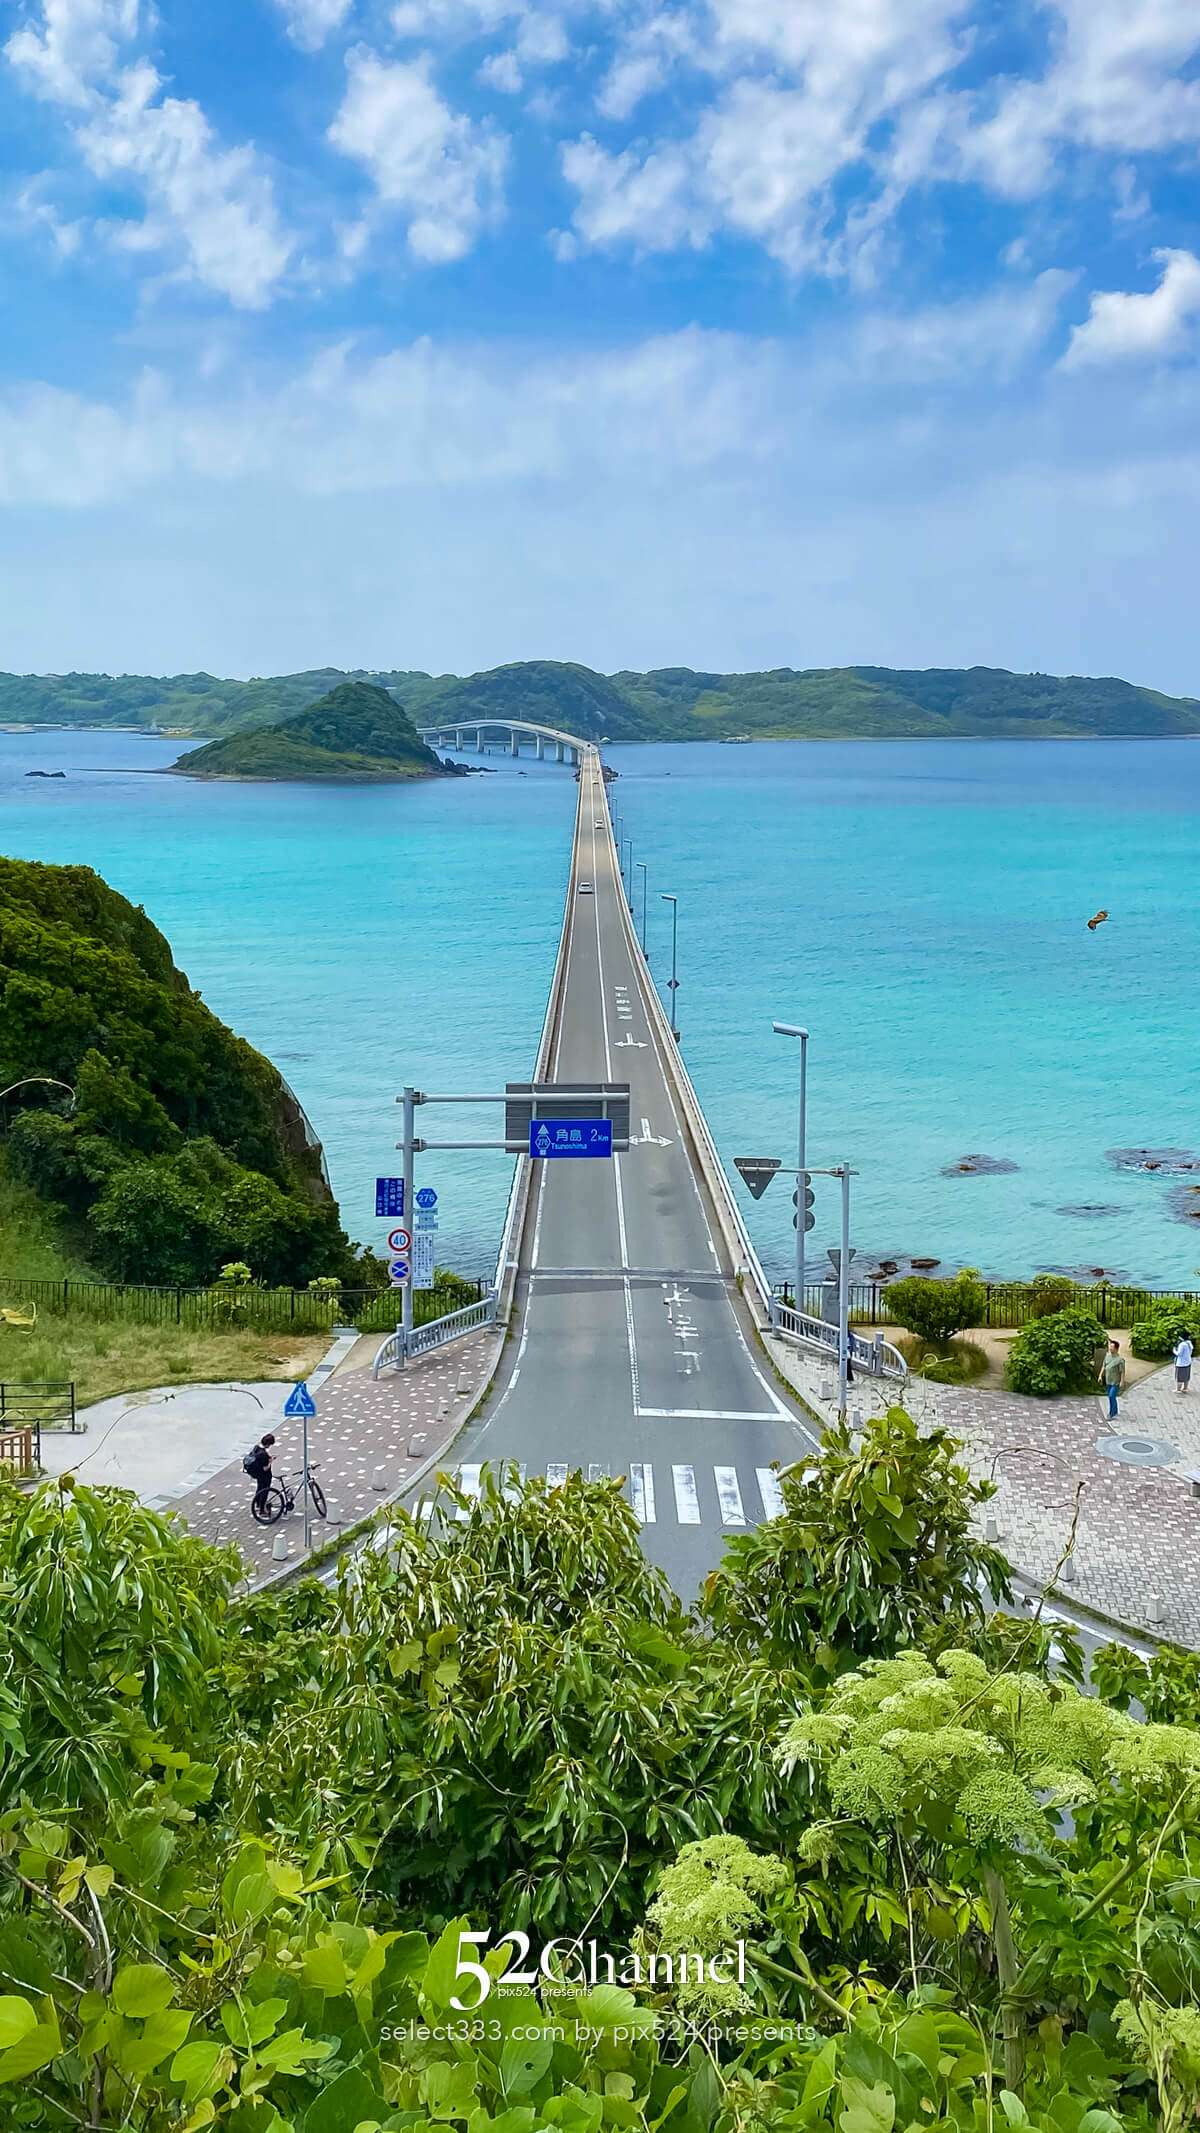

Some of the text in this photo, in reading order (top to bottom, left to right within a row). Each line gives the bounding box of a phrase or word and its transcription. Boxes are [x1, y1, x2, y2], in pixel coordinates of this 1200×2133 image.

[556, 1128, 582, 1142] 角島
[551, 1142, 587, 1150] Tsunoshima
[418, 1194, 436, 1203] 276
[393, 1235, 406, 1246] 40
